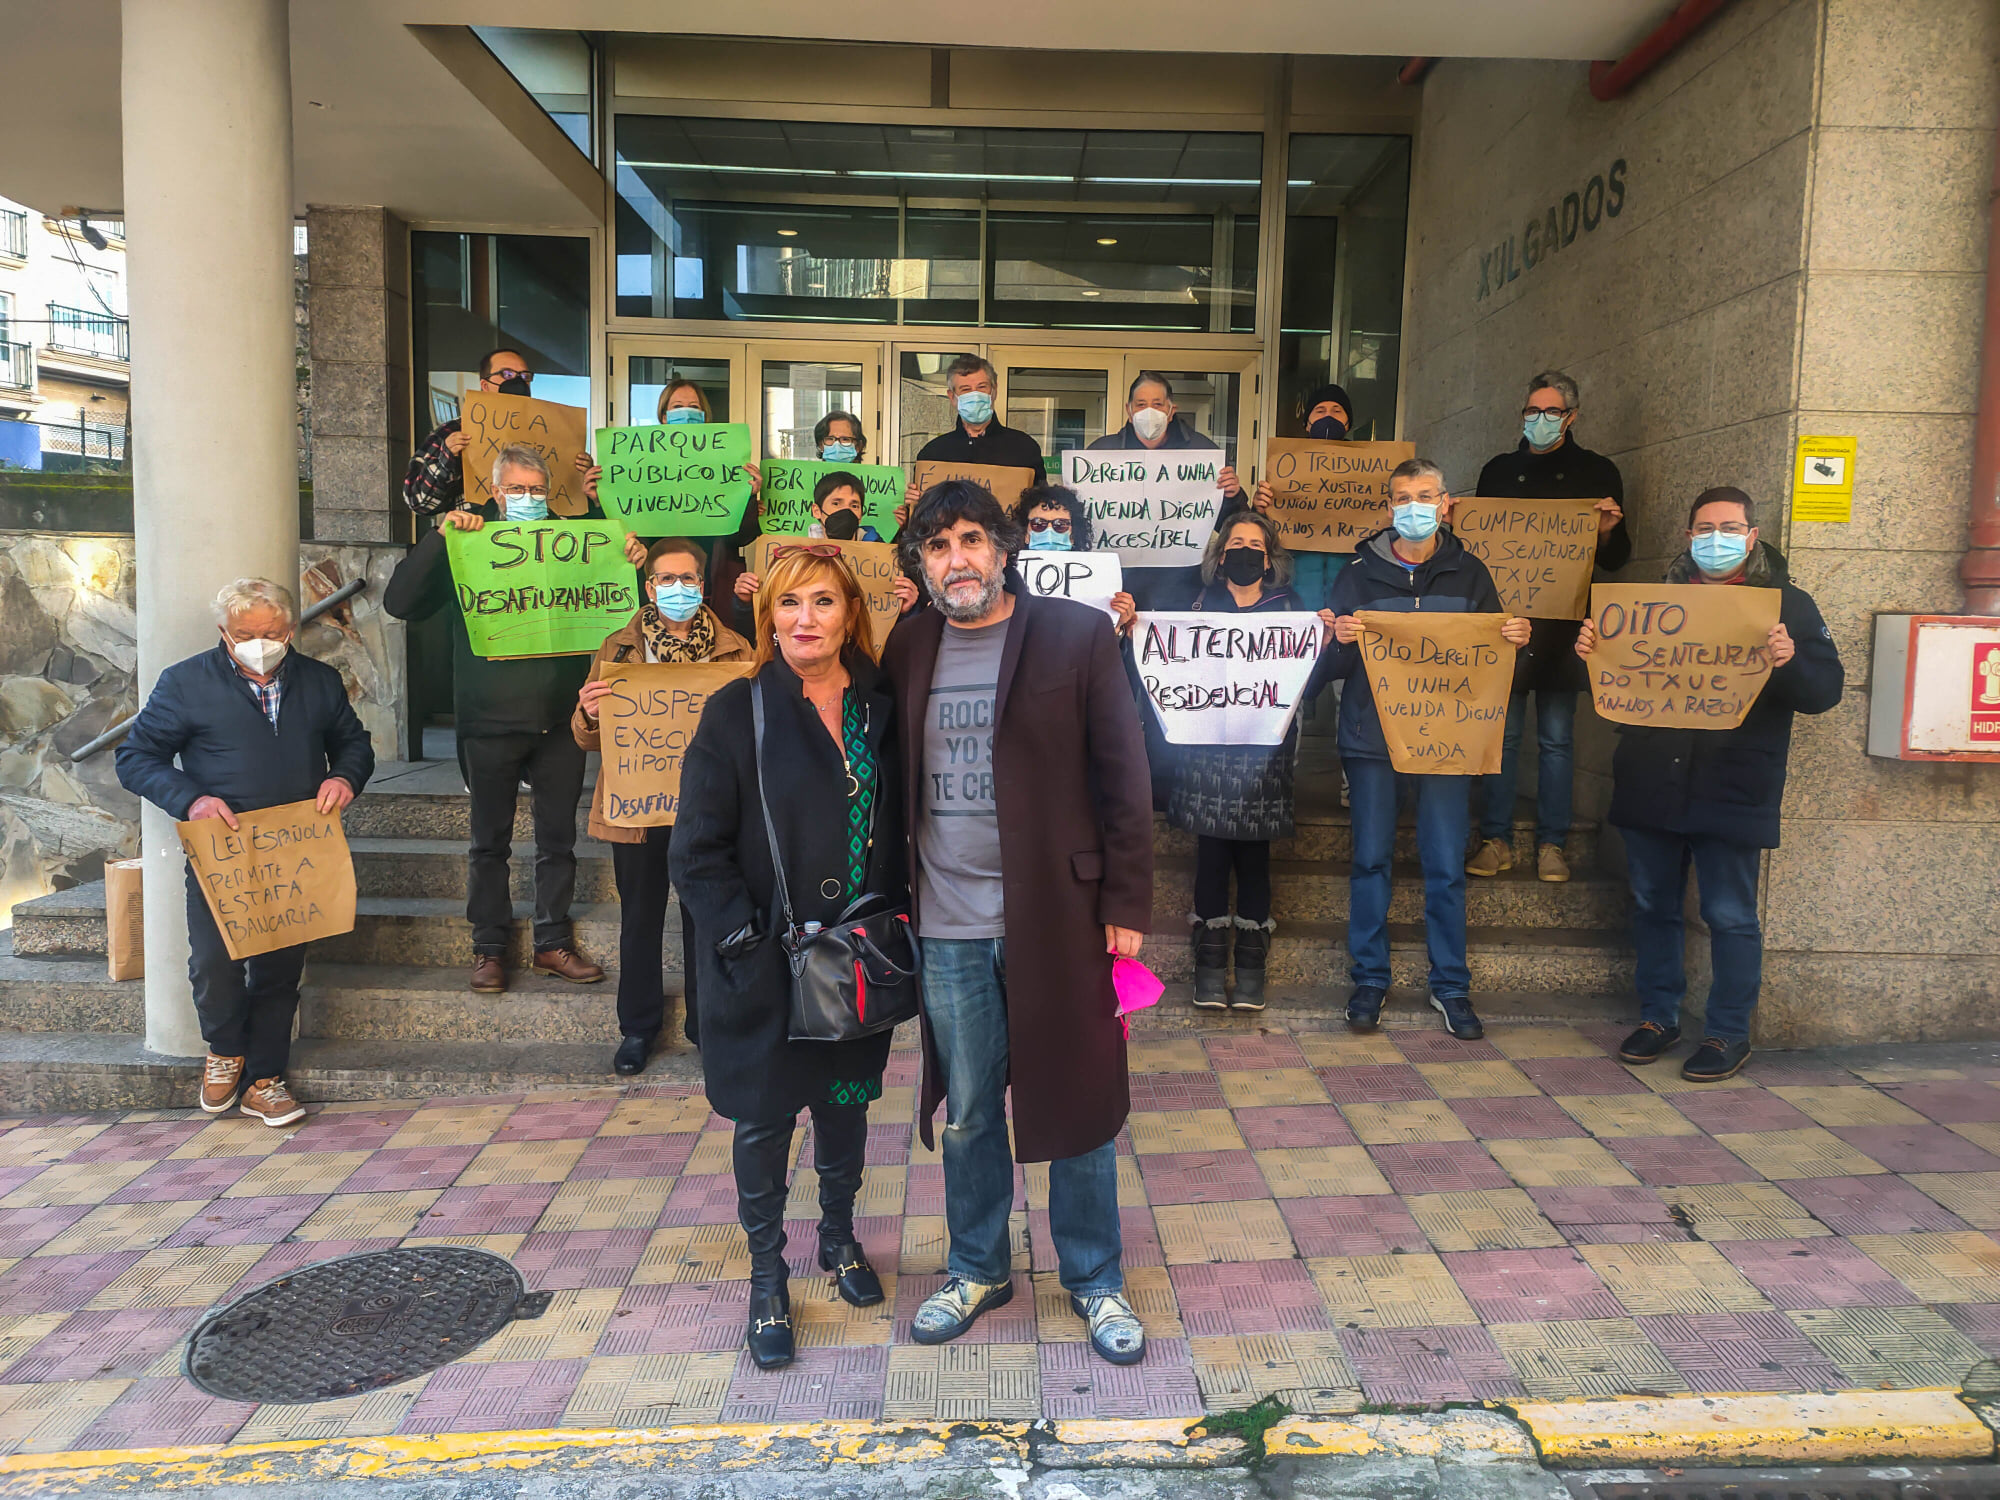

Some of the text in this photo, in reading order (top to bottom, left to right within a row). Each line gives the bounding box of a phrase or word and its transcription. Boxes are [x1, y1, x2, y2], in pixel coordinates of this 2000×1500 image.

[1477, 158, 1627, 302] XULGADOS
[470, 402, 548, 443] QUE A
[610, 430, 728, 458] PARQUE
[610, 458, 743, 484] PÚBLICO DE
[766, 466, 805, 491] POR
[1072, 456, 1216, 483] DEREITO A UNHA
[1276, 452, 1394, 478] O TRIBUNAL
[1281, 480, 1312, 493] DE
[1318, 478, 1372, 495] XUSTIZA
[617, 493, 731, 517] VIVENDAS
[1160, 499, 1214, 521] DIGNA
[1274, 496, 1389, 511] UNIÓN EUROPEA
[766, 519, 805, 533] SEN
[1322, 524, 1332, 537] A
[1461, 510, 1597, 536] CUMPRIMENTO
[489, 527, 611, 570] STOP
[1097, 525, 1201, 549] ACCESÍBEL
[1459, 537, 1490, 560] DAS
[1490, 565, 1556, 583] TXUE
[458, 581, 634, 617] DESAFIUZAMENTOS
[1599, 601, 1688, 640] OITO
[1142, 622, 1317, 665] ALTERNATIVA
[1363, 631, 1498, 666] POLO DEREITO
[1619, 640, 1770, 675] SENTENZAS
[1144, 675, 1290, 712] RESIDENCIAL
[1377, 676, 1472, 694] A UNHA
[1599, 670, 1728, 691] DO TXUE
[610, 678, 709, 719] SUSPE
[1385, 699, 1505, 723] IVENDA DIGNA
[1661, 697, 1675, 713] A
[938, 698, 996, 730] ROC
[945, 735, 978, 764] YO
[931, 772, 954, 800] TE
[211, 832, 246, 861] LEI
[252, 823, 333, 852] ESPAÑOLA
[207, 857, 315, 893] PERMITE A
[219, 880, 303, 914] ESTAFA
[225, 903, 325, 943] BANCARIA
